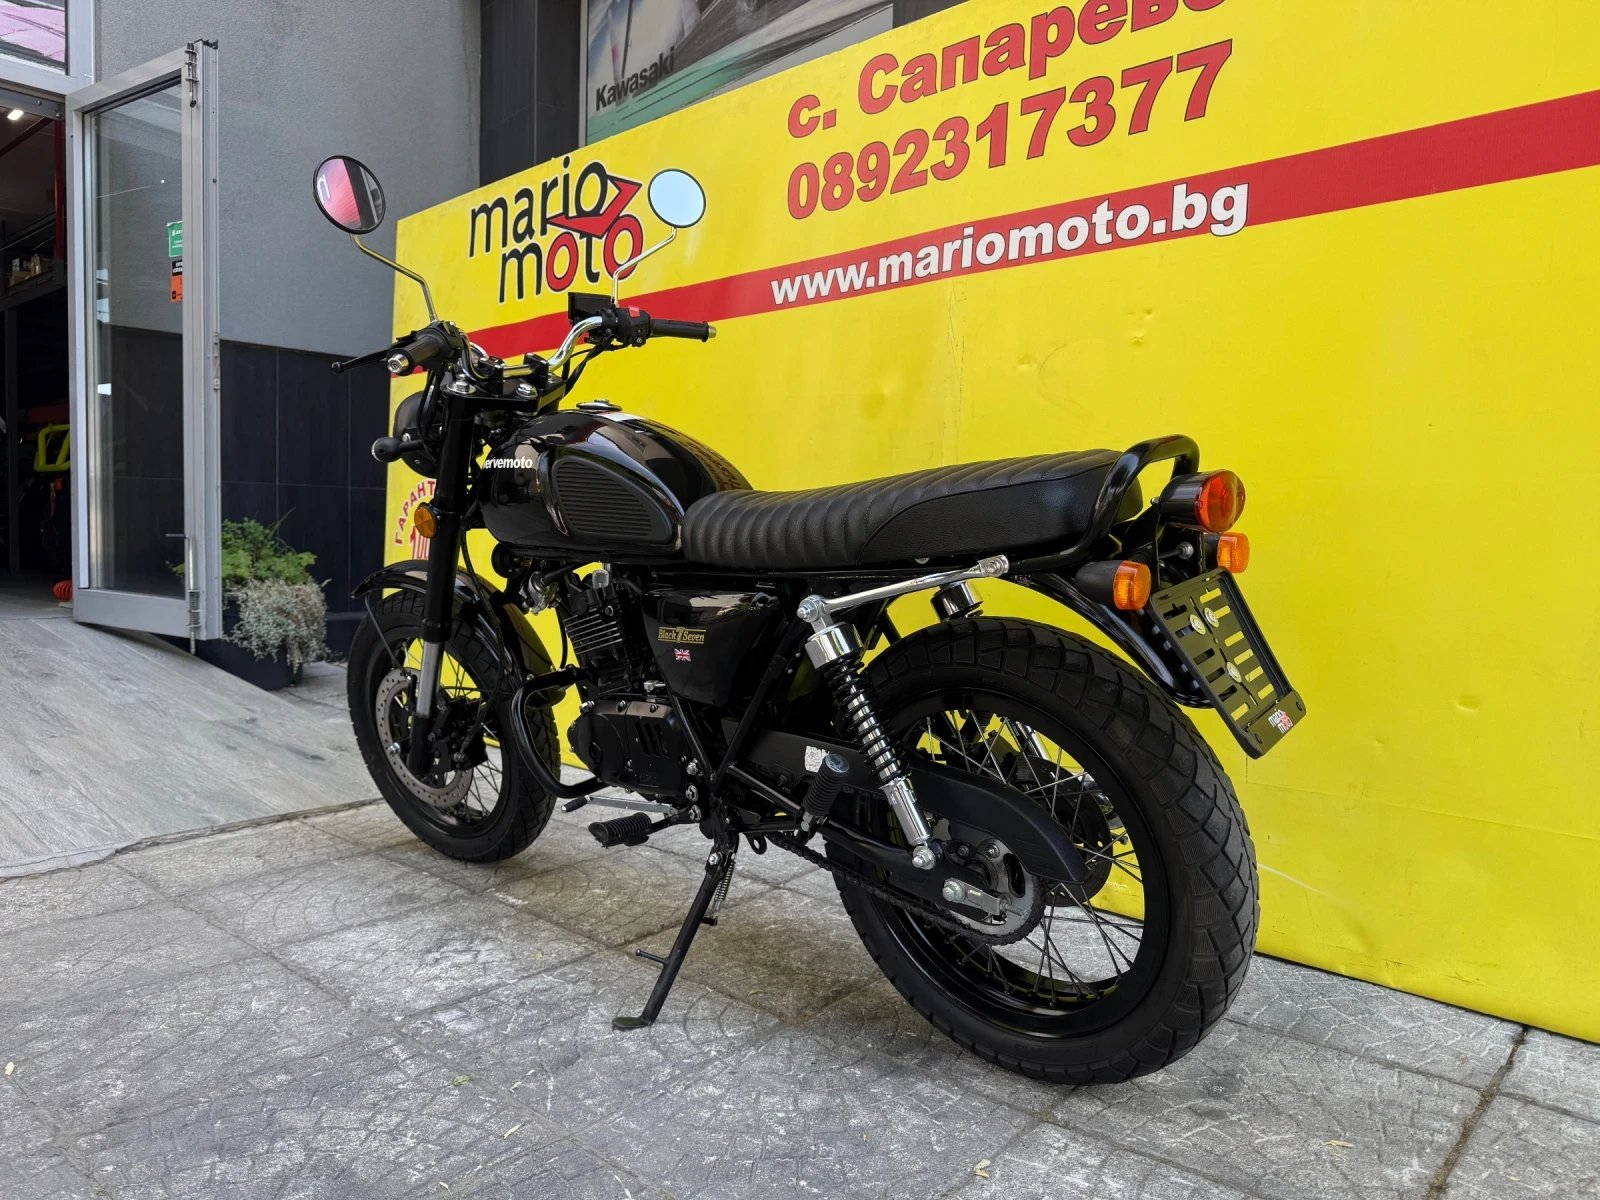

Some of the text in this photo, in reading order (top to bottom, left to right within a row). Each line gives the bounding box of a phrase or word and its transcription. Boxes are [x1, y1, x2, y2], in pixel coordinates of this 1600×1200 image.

[595, 45, 676, 112] Kawasaki
[787, 0, 1225, 139] с. Сапарев
[786, 38, 1233, 220] 0892317377
[469, 155, 609, 258] mario
[770, 181, 1250, 306] www.mariomoto.bg
[499, 213, 645, 304] moto
[483, 455, 533, 470] ervemoto
[658, 629, 676, 641] Black
[682, 630, 705, 642] Seven
